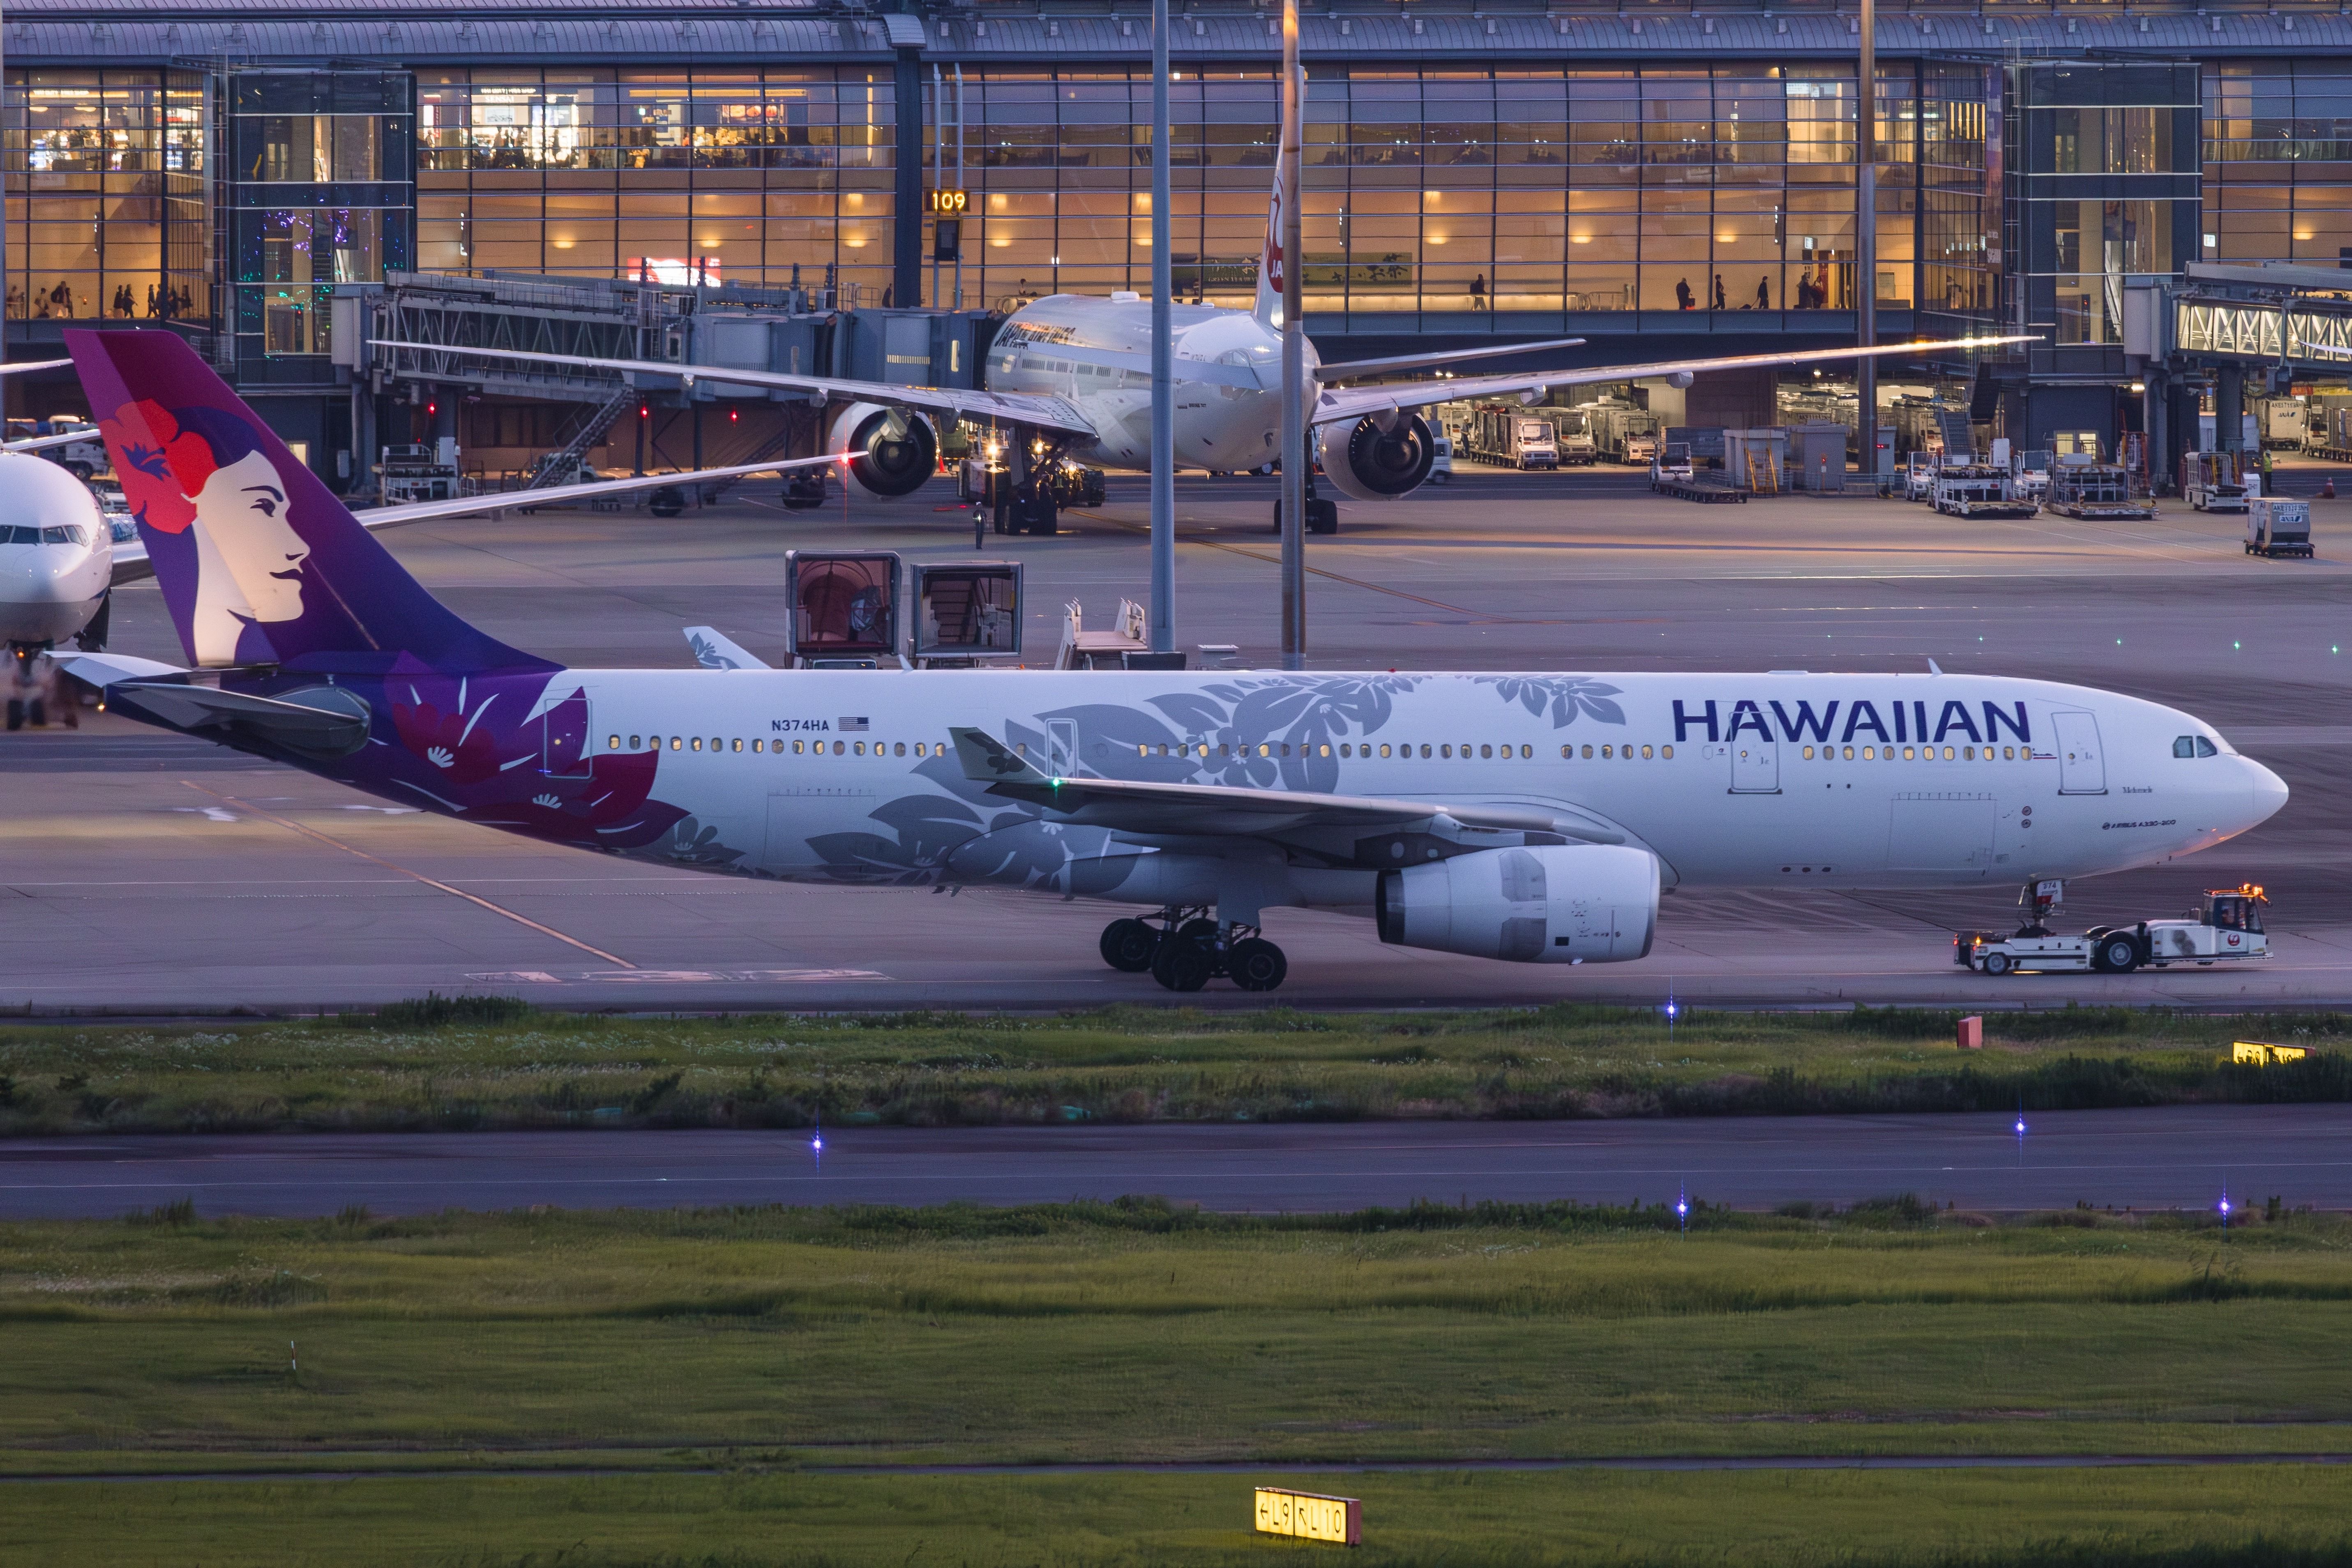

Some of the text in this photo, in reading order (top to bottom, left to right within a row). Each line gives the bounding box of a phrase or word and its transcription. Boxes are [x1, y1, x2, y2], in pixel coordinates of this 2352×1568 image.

[932, 192, 965, 210] 109
[1271, 259, 1283, 278] JA
[772, 719, 830, 731] N374HA
[1672, 700, 2031, 742] HAWAIIAN
[1273, 1500, 1342, 1533] L9 L10
